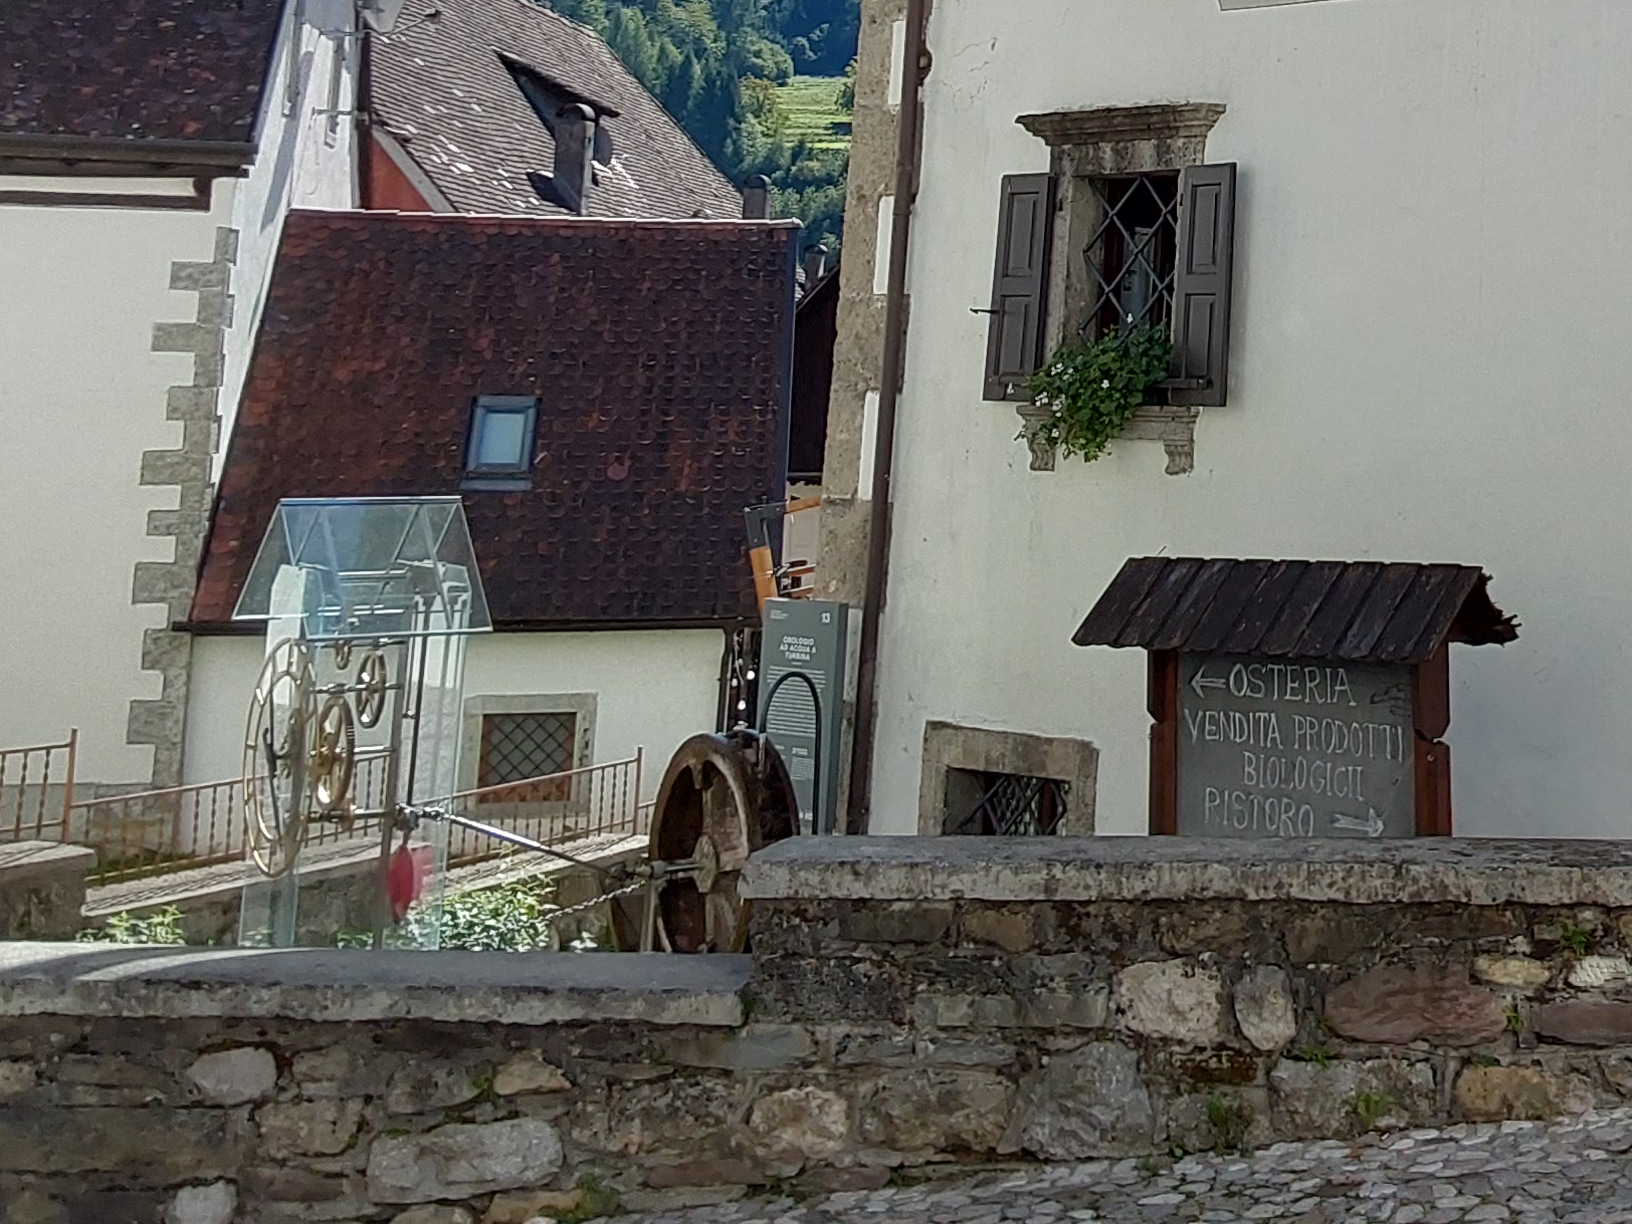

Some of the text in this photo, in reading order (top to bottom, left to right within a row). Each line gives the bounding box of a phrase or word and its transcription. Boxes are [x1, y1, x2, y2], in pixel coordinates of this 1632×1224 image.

[1228, 662, 1357, 707] OSTERIA
[1183, 708, 1404, 763] VENDITA PRODOTTI
[1203, 787, 1315, 838] RISTORO
